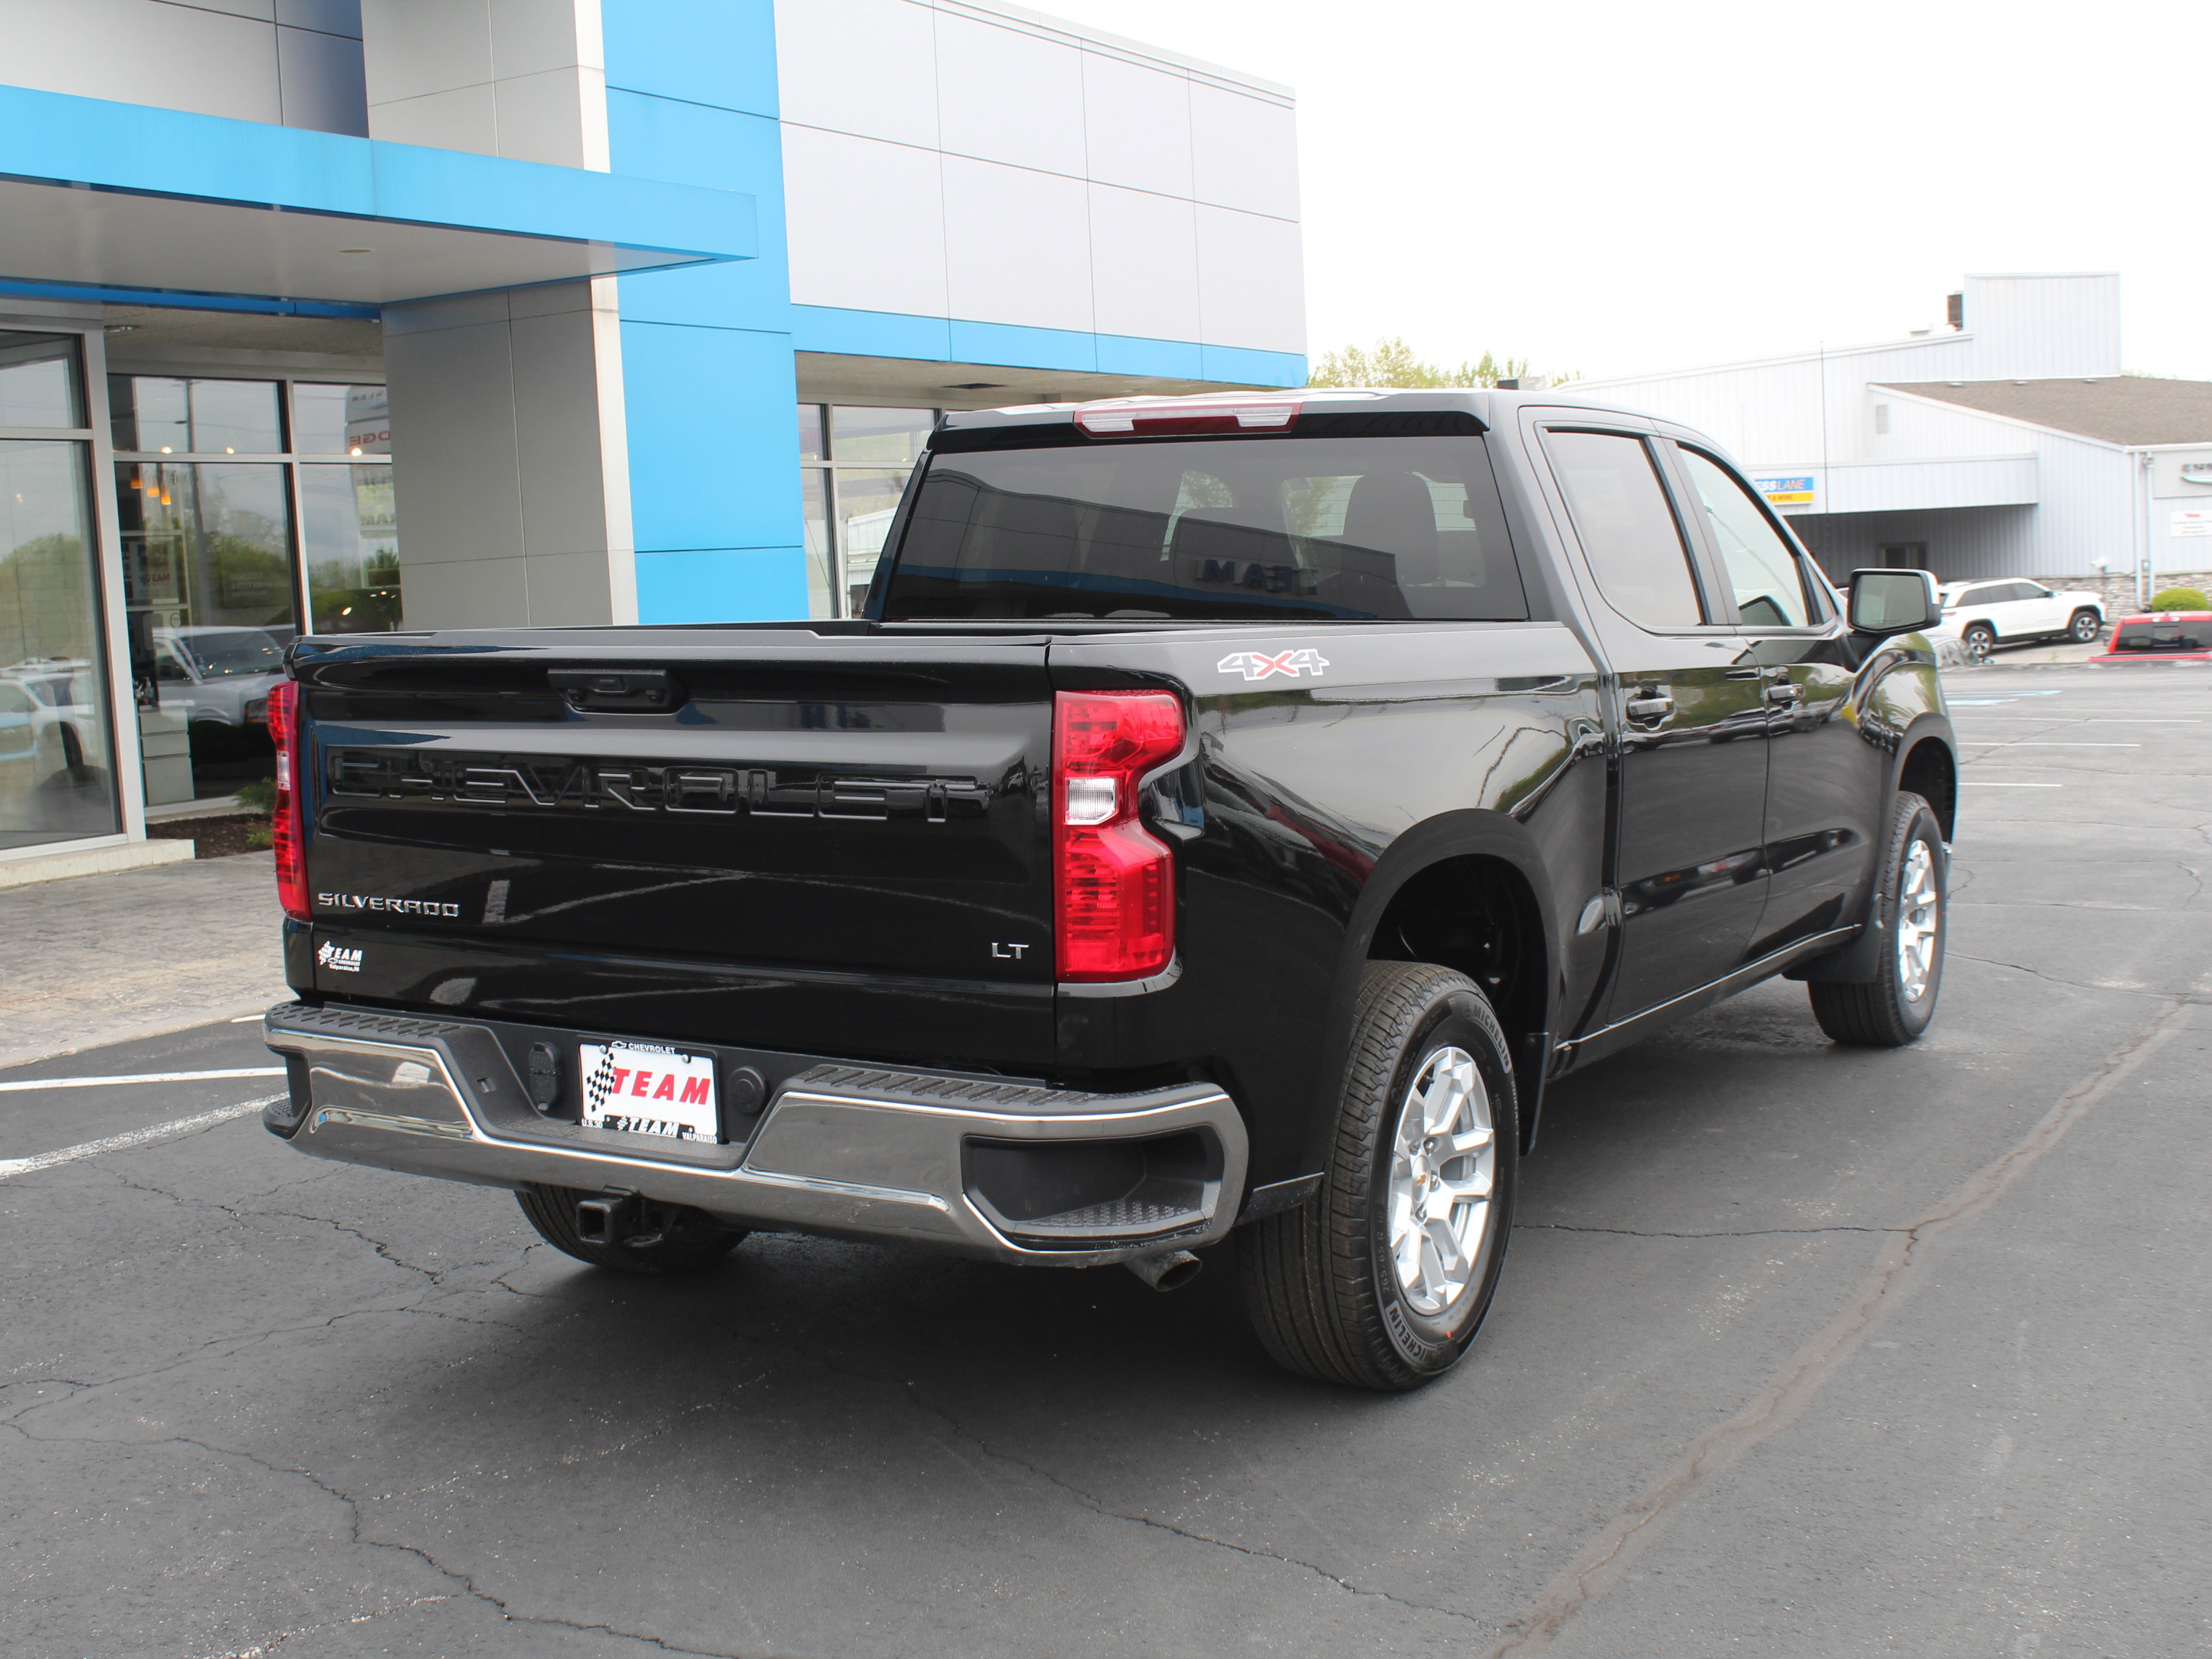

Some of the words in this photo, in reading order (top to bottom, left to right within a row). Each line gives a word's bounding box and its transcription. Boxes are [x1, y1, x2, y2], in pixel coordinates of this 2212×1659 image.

[331, 755, 978, 823] CHEVROLET
[318, 892, 461, 917] SILVERADO
[328, 946, 363, 961] TEAM
[992, 942, 1030, 959] LT
[1473, 1004, 1510, 1068] MICHELIN
[628, 1042, 675, 1055] CHEVROLET
[612, 1067, 711, 1105] TEAM
[628, 1116, 680, 1137] TEAM
[682, 1131, 718, 1144] VALPARAISO
